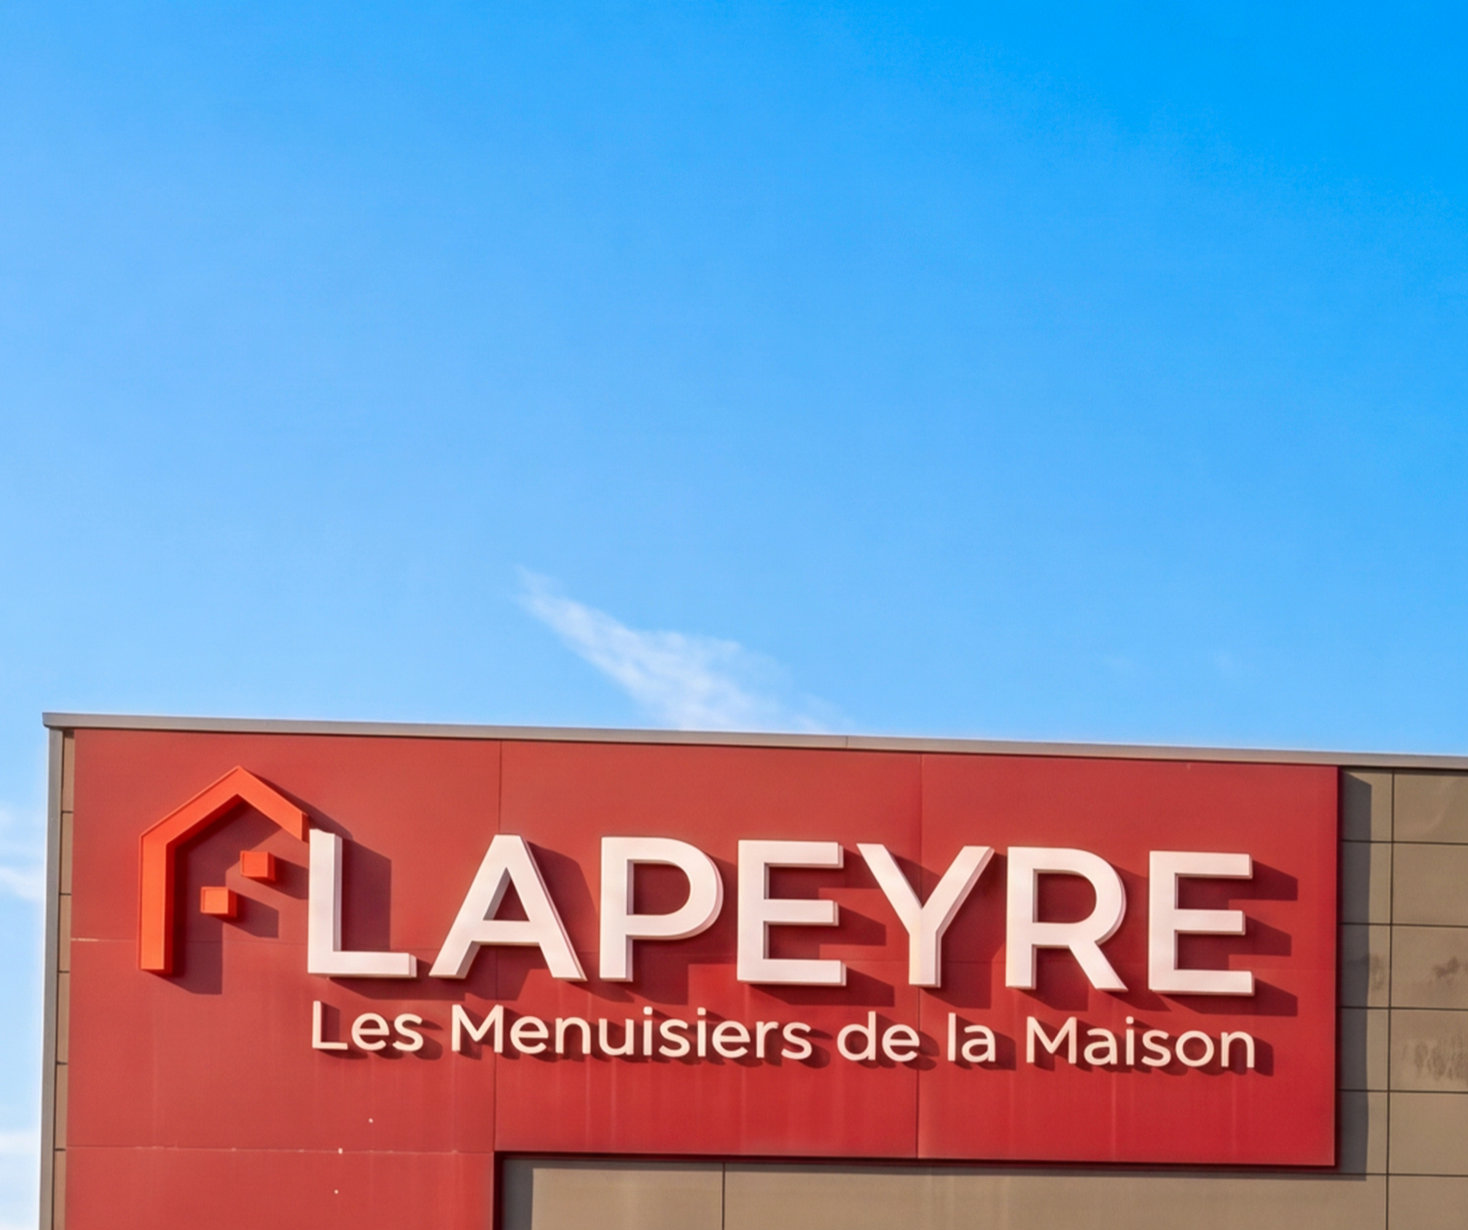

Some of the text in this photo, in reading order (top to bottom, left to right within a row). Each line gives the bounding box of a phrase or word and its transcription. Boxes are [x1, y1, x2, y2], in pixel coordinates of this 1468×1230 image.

[305, 826, 1256, 996] LAPEYRE
[311, 999, 1255, 1069] Les Menuisiers de la Maison
